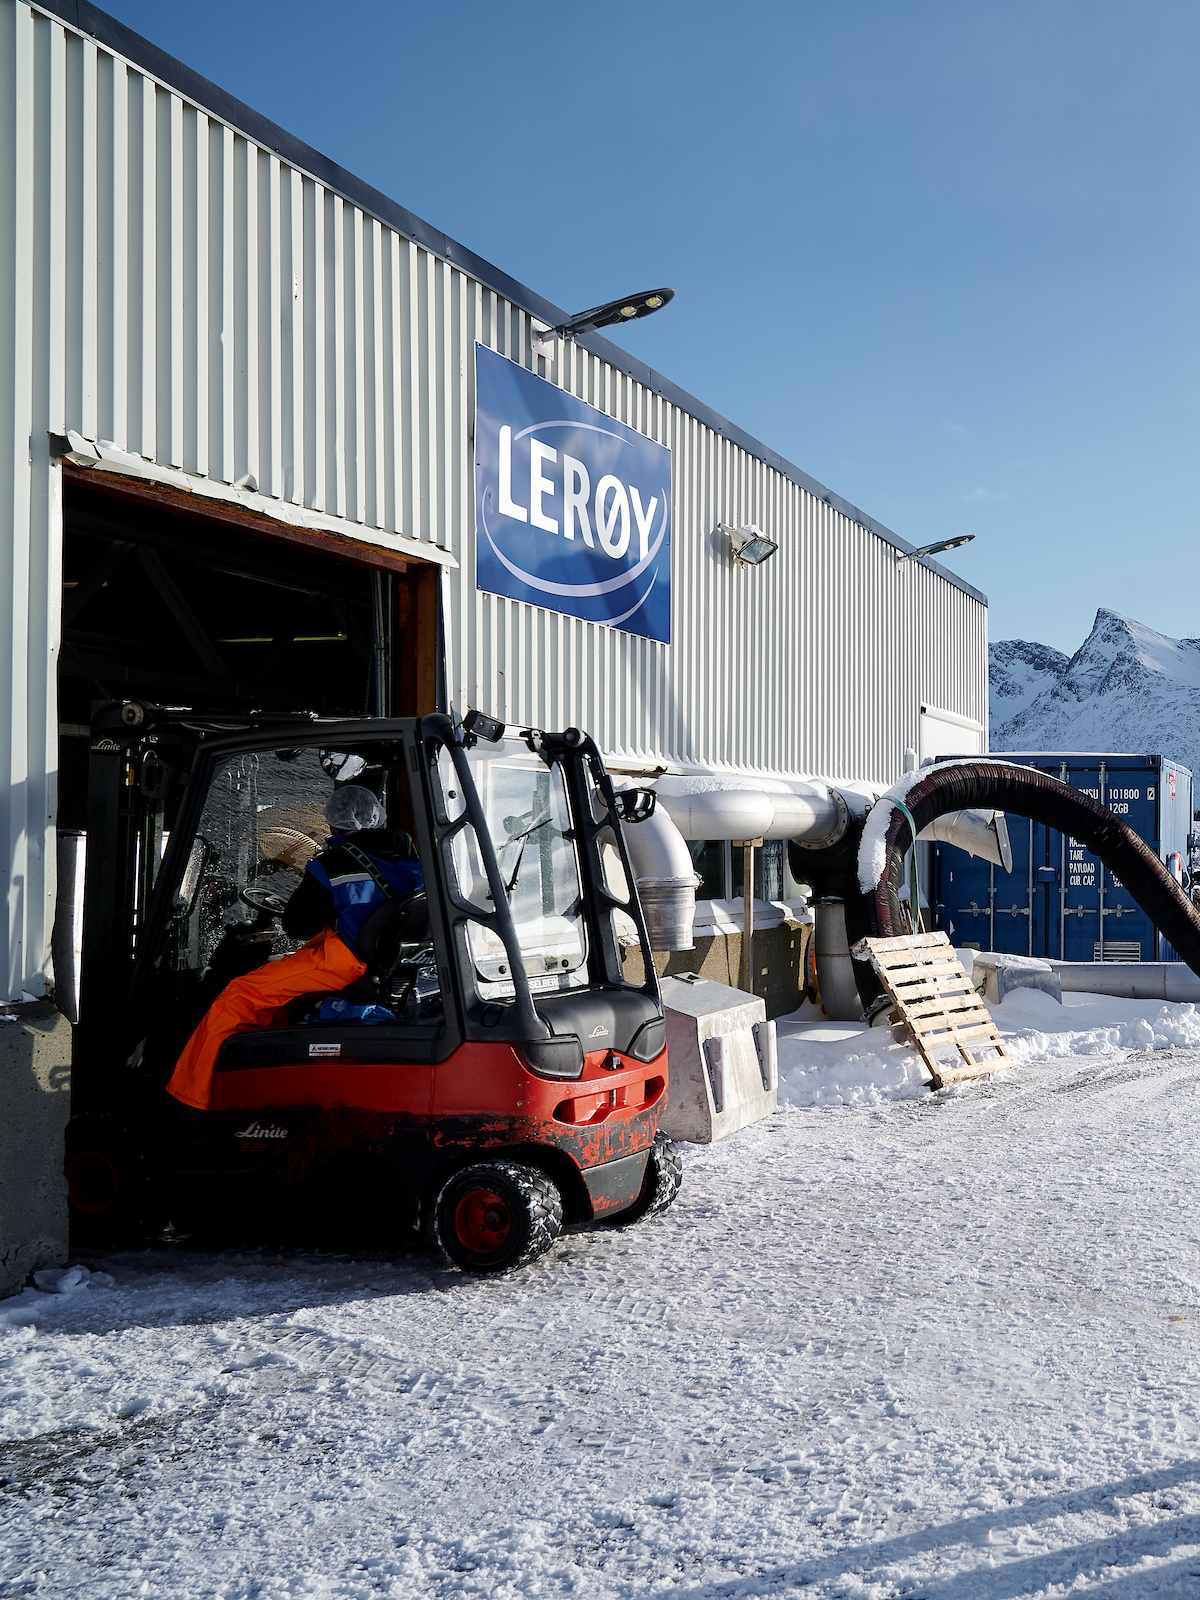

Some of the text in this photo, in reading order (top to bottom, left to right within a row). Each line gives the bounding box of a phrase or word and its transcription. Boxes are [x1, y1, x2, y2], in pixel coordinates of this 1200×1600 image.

[498, 424, 659, 562] LERØY
[90, 738, 121, 751] Linde
[1108, 788, 1140, 800] 101800
[1108, 802, 1129, 814] 12GB
[1069, 849, 1084, 861] TARE
[1069, 862, 1096, 874] PAYLOAD
[1082, 875, 1096, 887] CAP.
[234, 1119, 288, 1139] Linde
